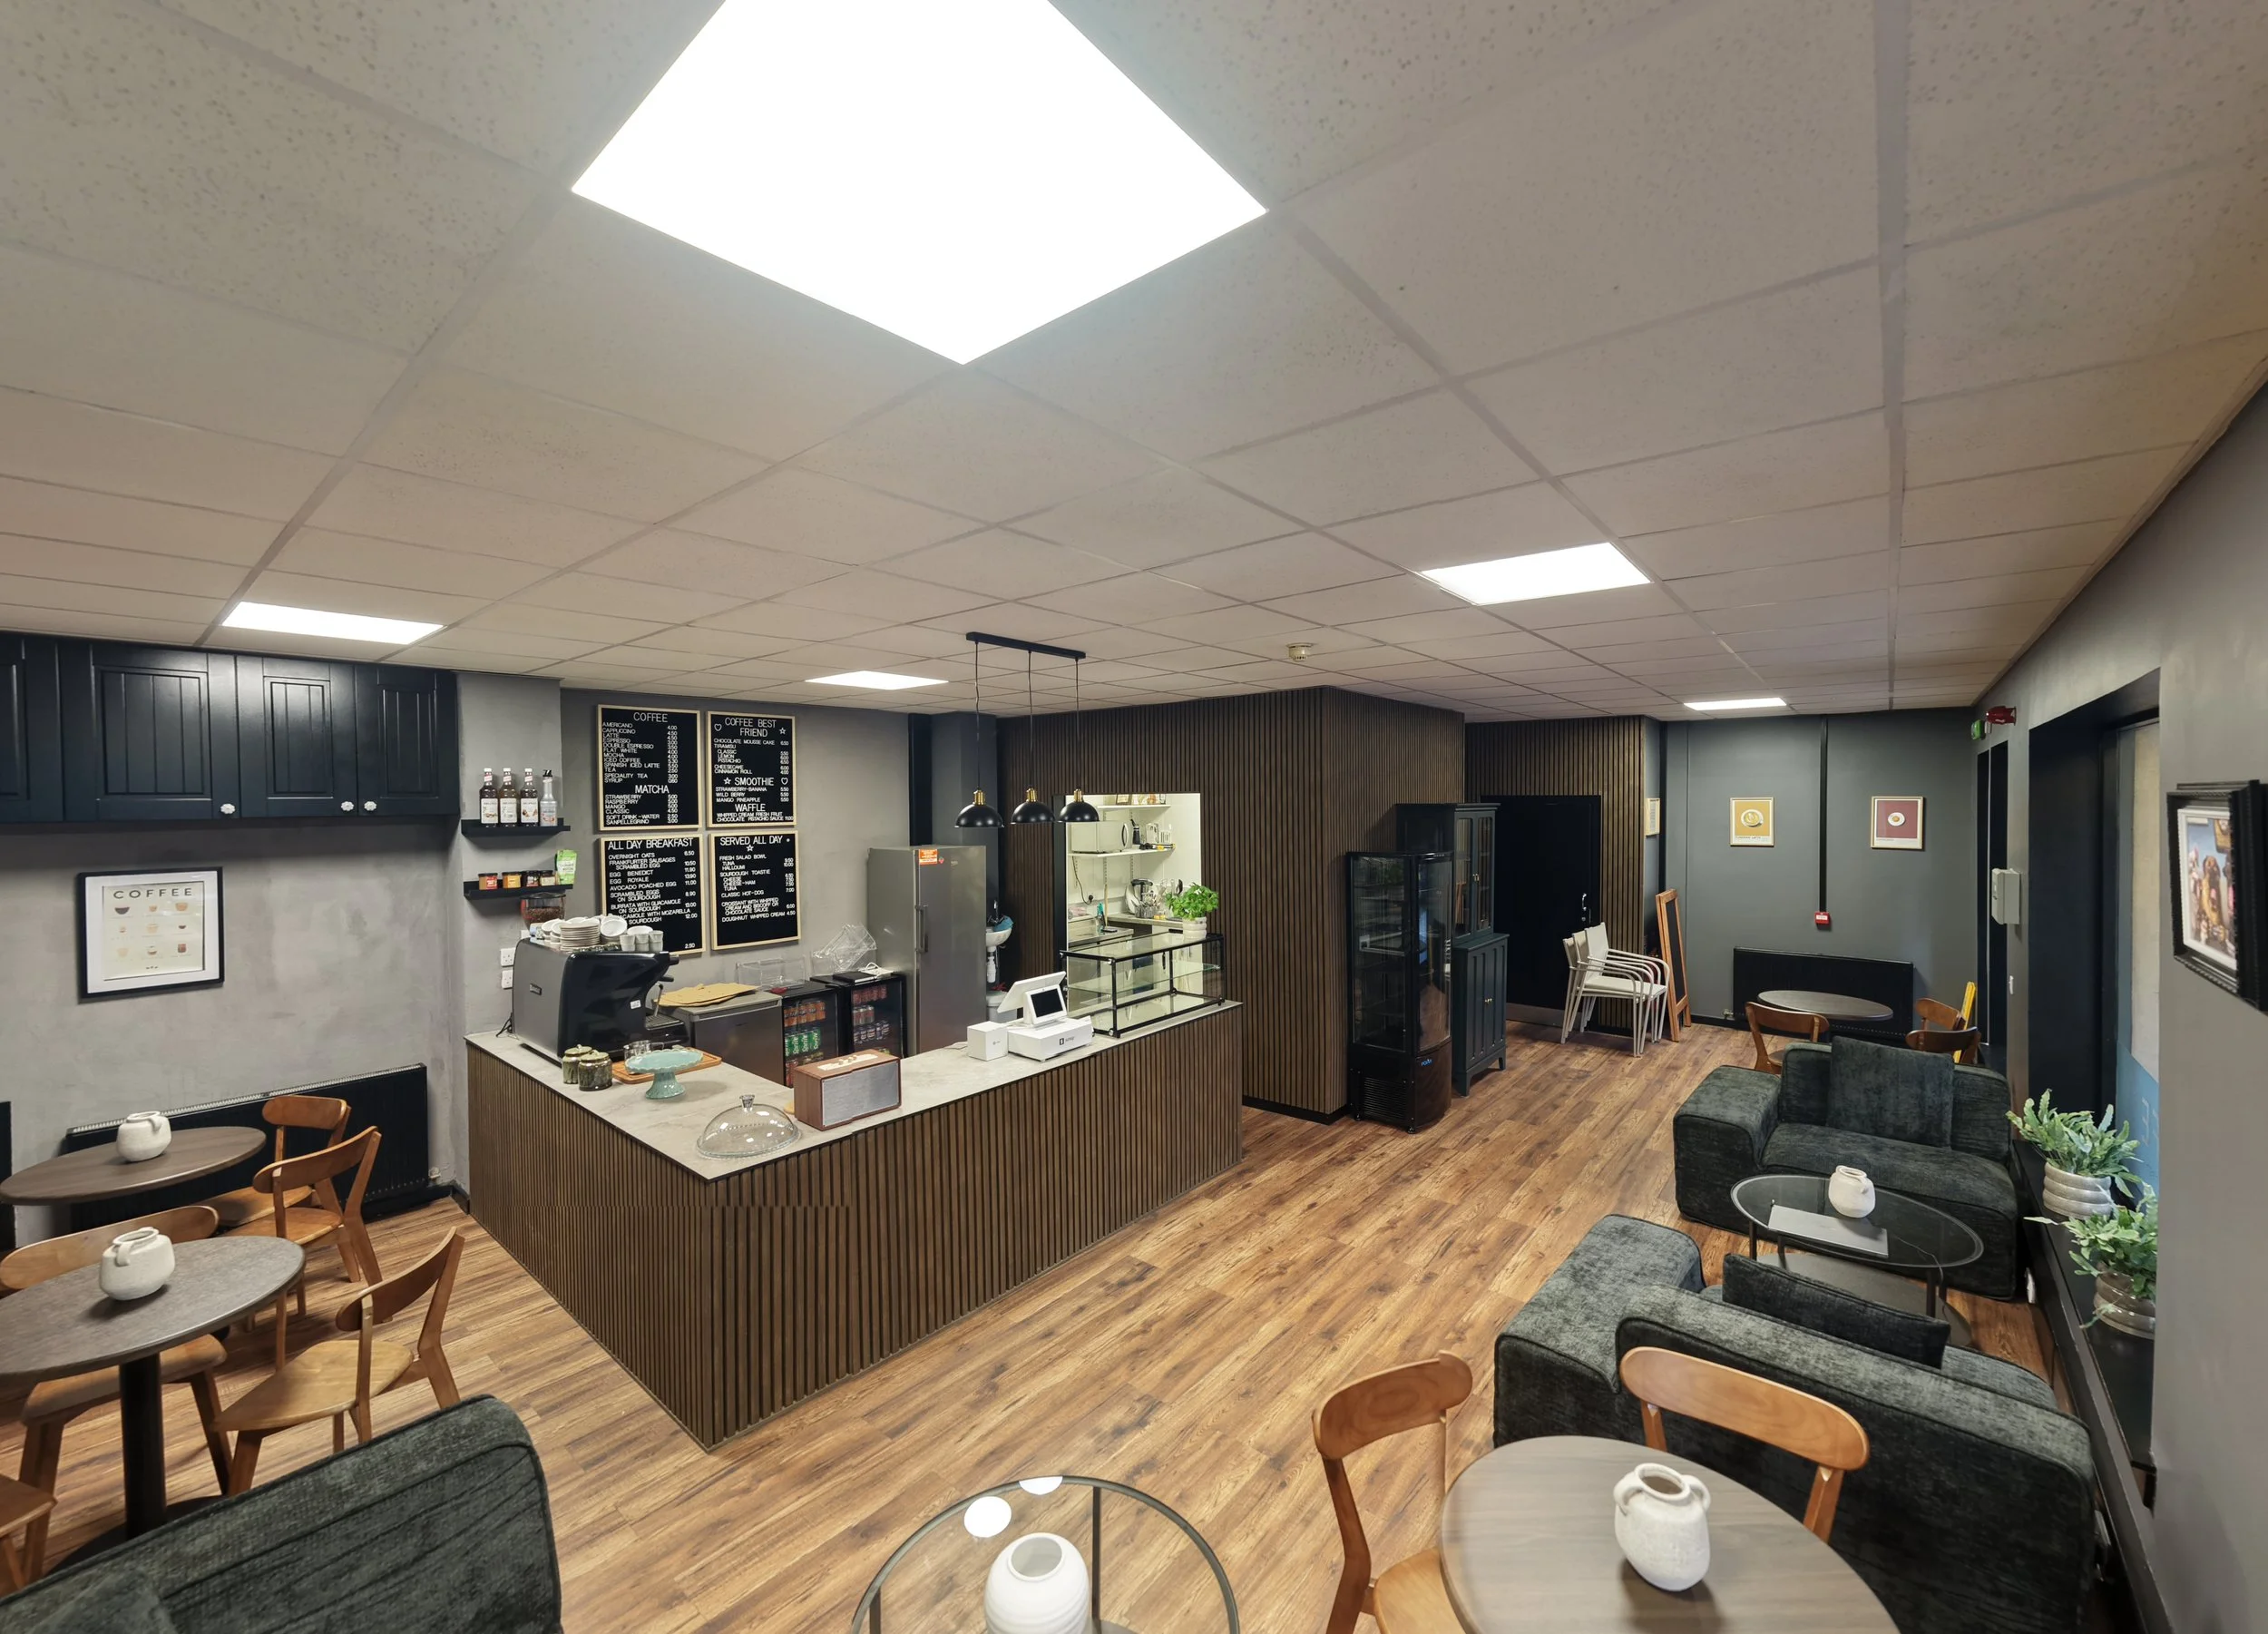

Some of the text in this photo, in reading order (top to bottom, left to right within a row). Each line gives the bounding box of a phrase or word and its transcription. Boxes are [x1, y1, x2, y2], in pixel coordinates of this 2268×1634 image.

[633, 712, 668, 722] COFFEE
[725, 718, 777, 728] COFFEE BEST
[740, 728, 767, 737] FRIEND
[735, 778, 774, 786] SMOOTHIE
[635, 785, 669, 793] MATCHA
[608, 838, 693, 850] ALL DAY BREAKFAST
[720, 837, 750, 846] SERVED
[769, 836, 783, 844] DAY
[113, 888, 192, 899] COFFEE
